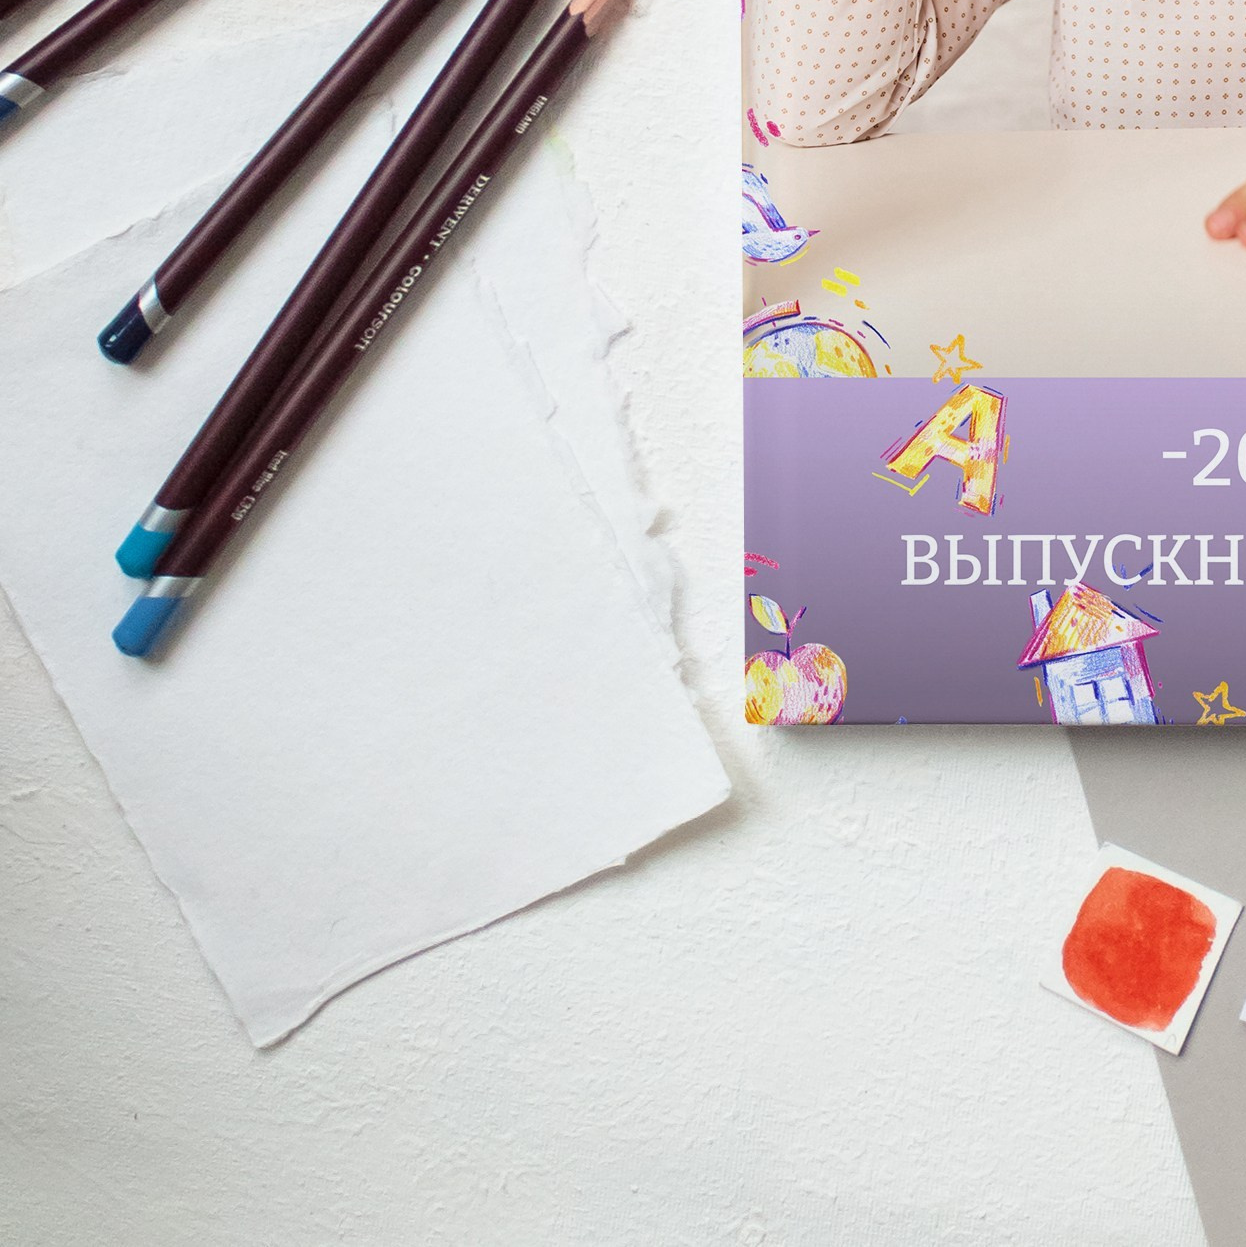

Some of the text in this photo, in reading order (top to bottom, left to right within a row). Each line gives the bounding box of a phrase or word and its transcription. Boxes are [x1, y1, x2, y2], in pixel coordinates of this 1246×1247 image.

[515, 95, 548, 134] ENGLAND
[429, 174, 491, 251] DERWENT
[354, 265, 423, 351] coloursoft
